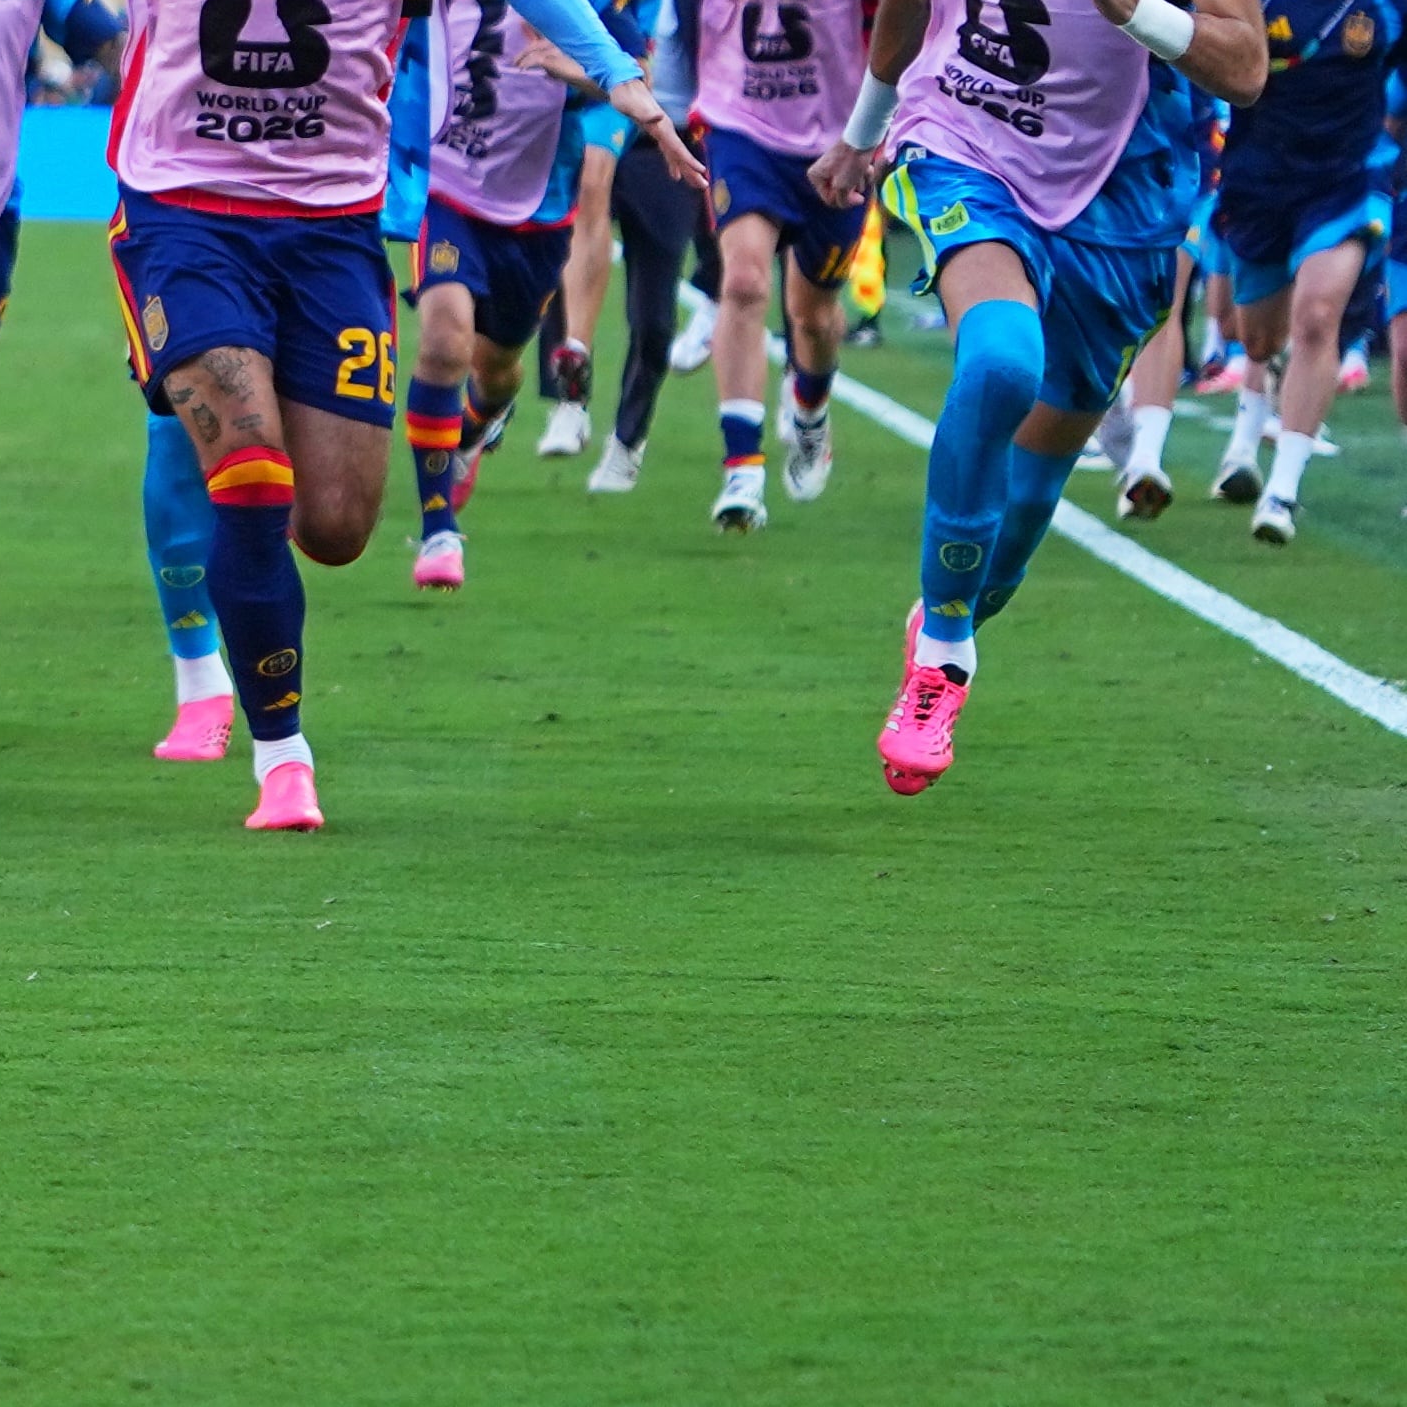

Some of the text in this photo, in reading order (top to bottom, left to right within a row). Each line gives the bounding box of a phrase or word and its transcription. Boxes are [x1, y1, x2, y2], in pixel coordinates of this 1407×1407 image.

[232, 50, 296, 73] FIFA
[196, 90, 328, 113] WORLD CUP
[195, 112, 326, 143] 2026
[335, 327, 396, 405] 26
